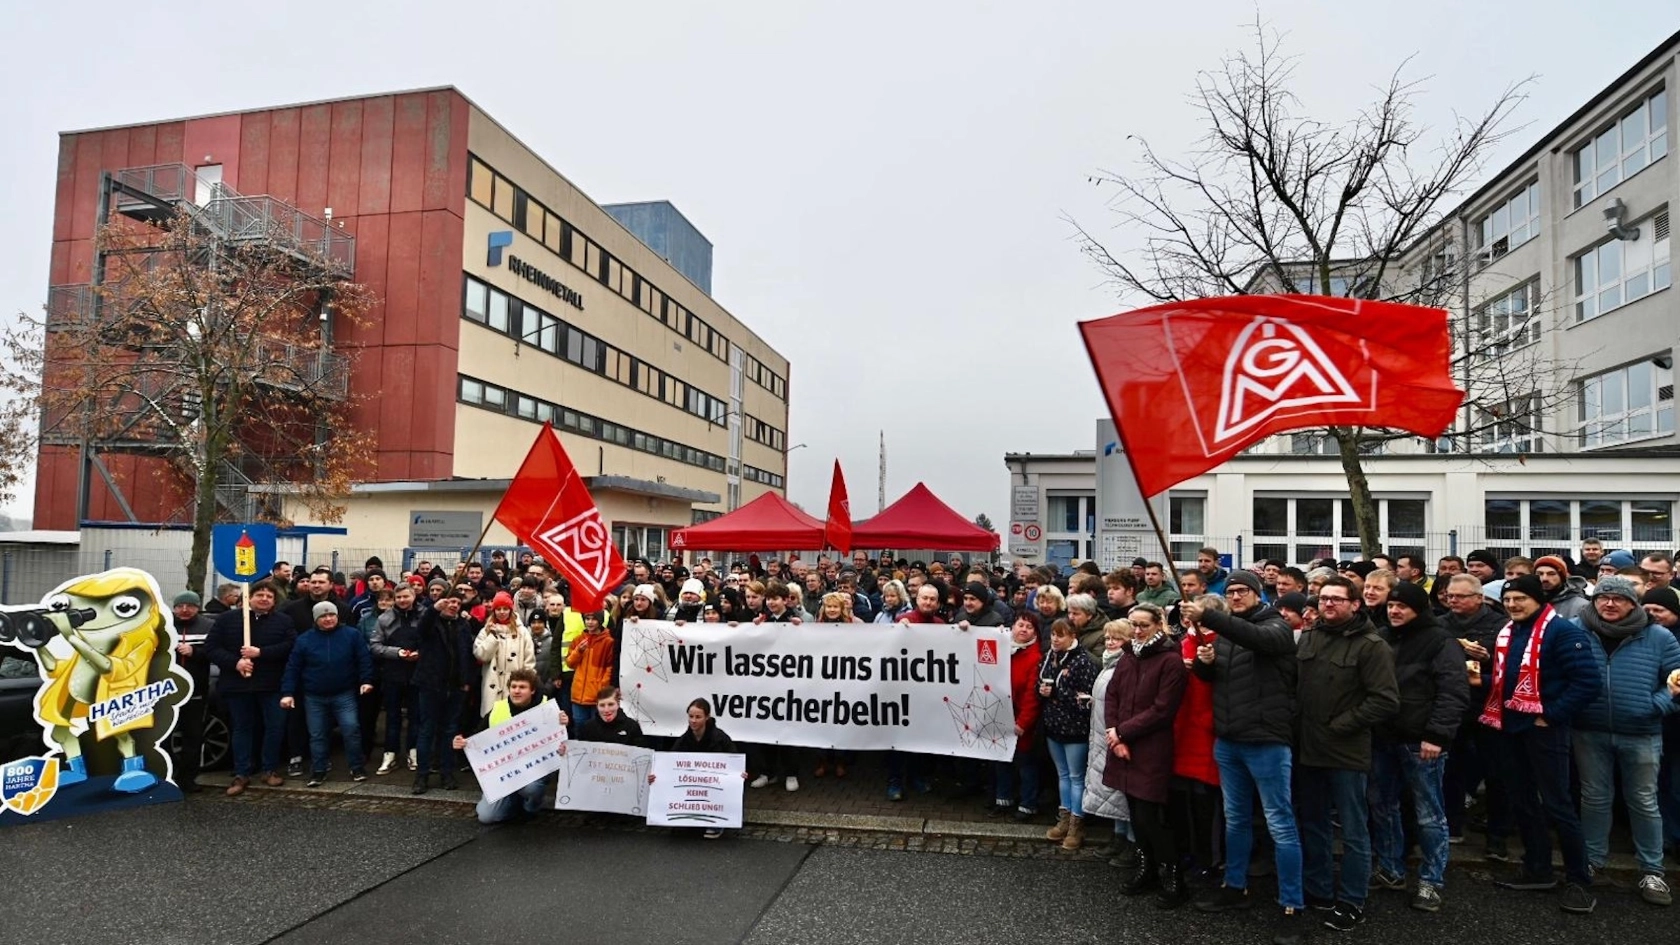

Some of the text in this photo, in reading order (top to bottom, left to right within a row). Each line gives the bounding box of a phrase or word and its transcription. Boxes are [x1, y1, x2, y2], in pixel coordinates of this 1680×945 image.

[508, 254, 584, 311] RHEINMETALL
[1029, 528, 1037, 537] 10
[668, 643, 960, 684] Wir lassen uns nicht
[92, 680, 175, 720] HARTHA
[711, 689, 910, 727] verscherbeln!
[498, 719, 528, 737] OHNE
[676, 760, 727, 769] WIR WOLLEN
[6, 765, 34, 777] 800
[5, 774, 35, 785] JAHRE
[5, 782, 34, 790] HARTHA
[686, 789, 708, 797] KEINE
